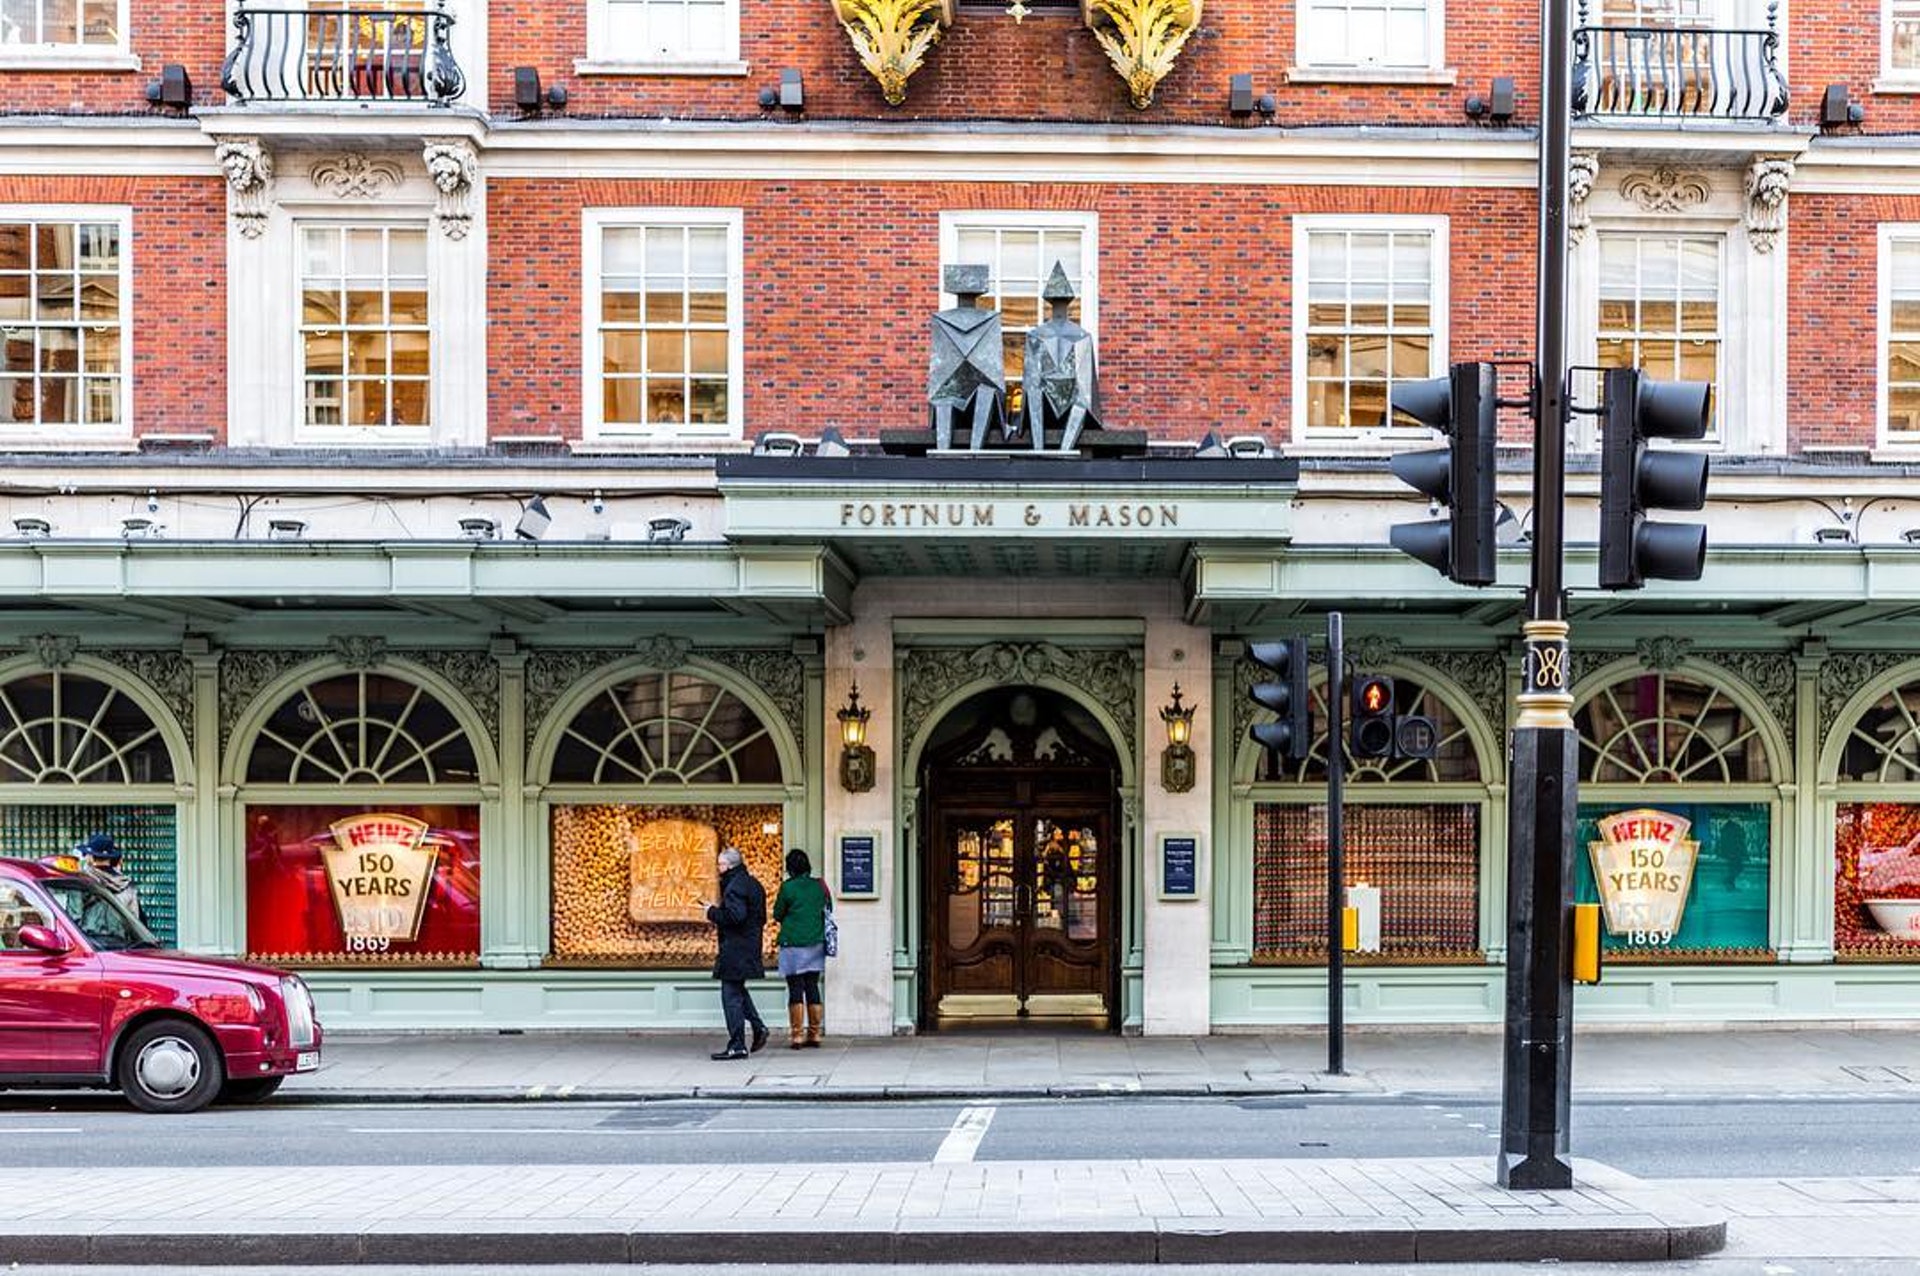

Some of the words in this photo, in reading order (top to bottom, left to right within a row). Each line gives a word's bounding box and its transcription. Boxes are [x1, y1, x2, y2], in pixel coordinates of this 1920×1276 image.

[840, 504, 995, 526] FORTNUM
[1023, 505, 1041, 526] &
[1068, 504, 1180, 526] MASON
[348, 823, 414, 847] HEINZ
[1612, 819, 1675, 843] HEINZ
[640, 832, 709, 853] BEANZ
[358, 853, 394, 873] 150
[1630, 848, 1664, 869] 150
[638, 860, 710, 880] MEANZ
[338, 877, 412, 897] YEARS
[1610, 872, 1682, 893] YEARS
[639, 889, 707, 909] HEINZ
[345, 932, 391, 951] 1869
[1627, 929, 1672, 945] 1869
